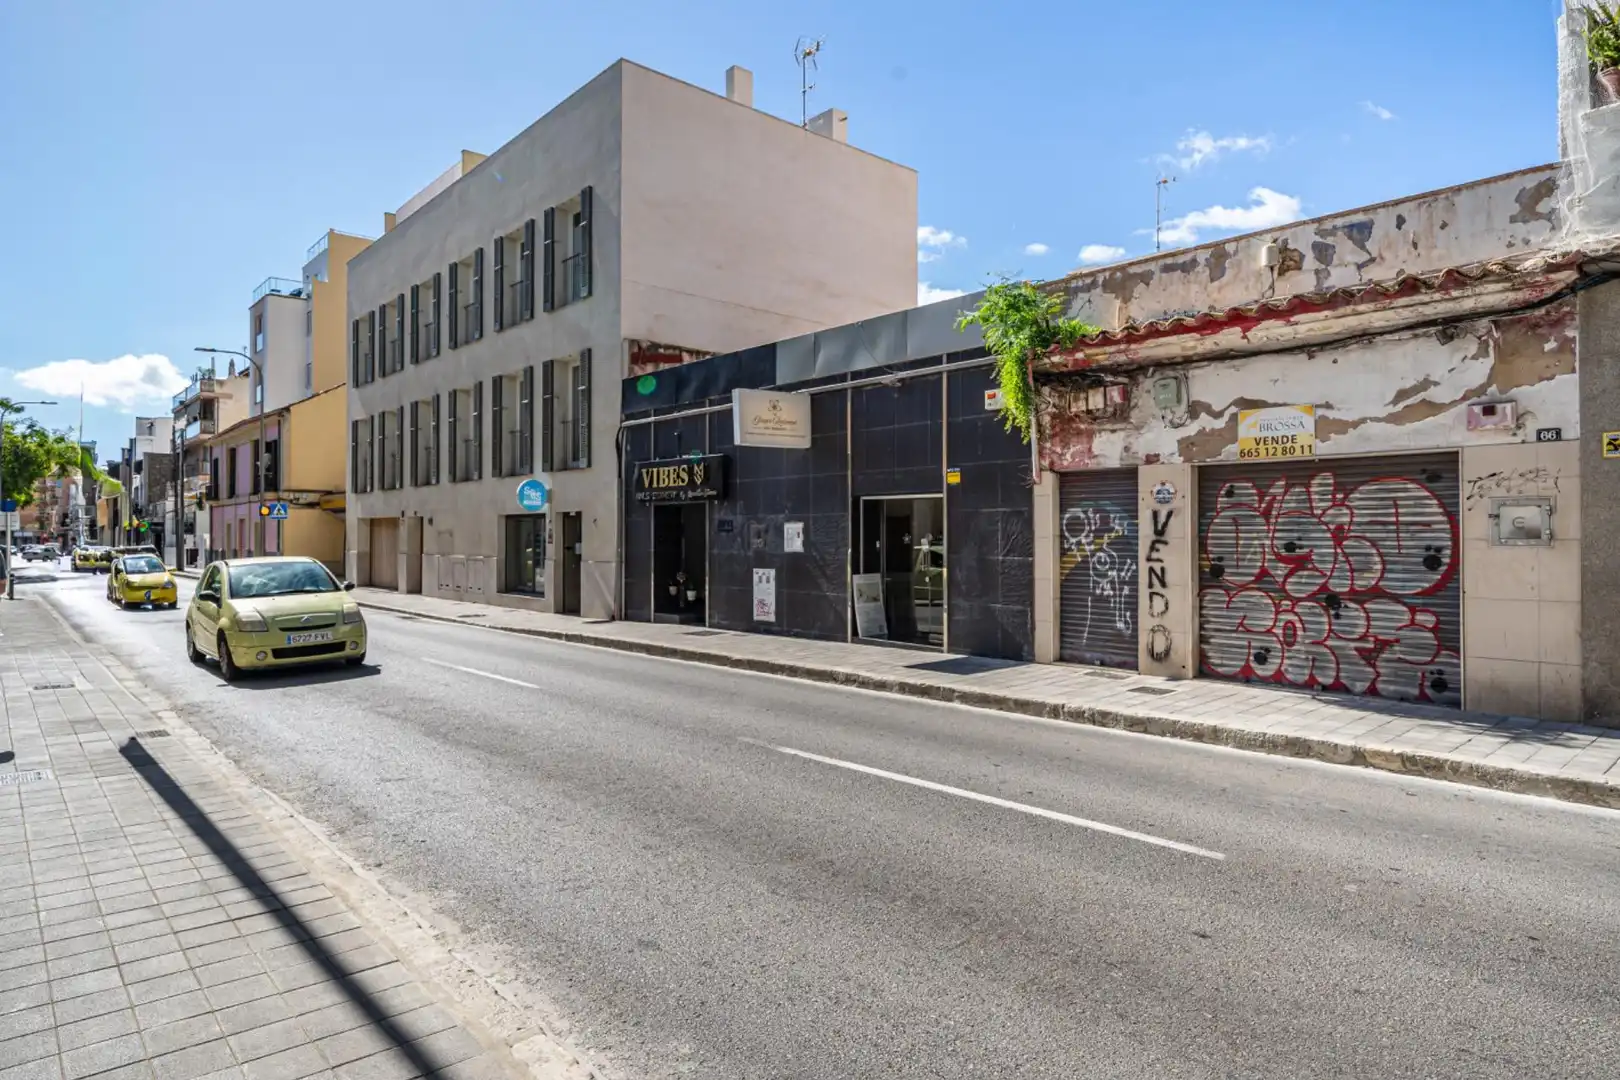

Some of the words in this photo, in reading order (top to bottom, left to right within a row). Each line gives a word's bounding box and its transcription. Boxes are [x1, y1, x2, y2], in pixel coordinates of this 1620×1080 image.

[1259, 420, 1305, 433] BROSSA
[1254, 434, 1298, 446] VENDE
[1540, 430, 1557, 440] 66
[1240, 447, 1260, 458] 665
[1265, 446, 1278, 456] 12
[1281, 445, 1296, 456] 80
[1300, 443, 1312, 455] 11
[641, 464, 689, 489] VIBES
[1146, 509, 1174, 662] VENDO
